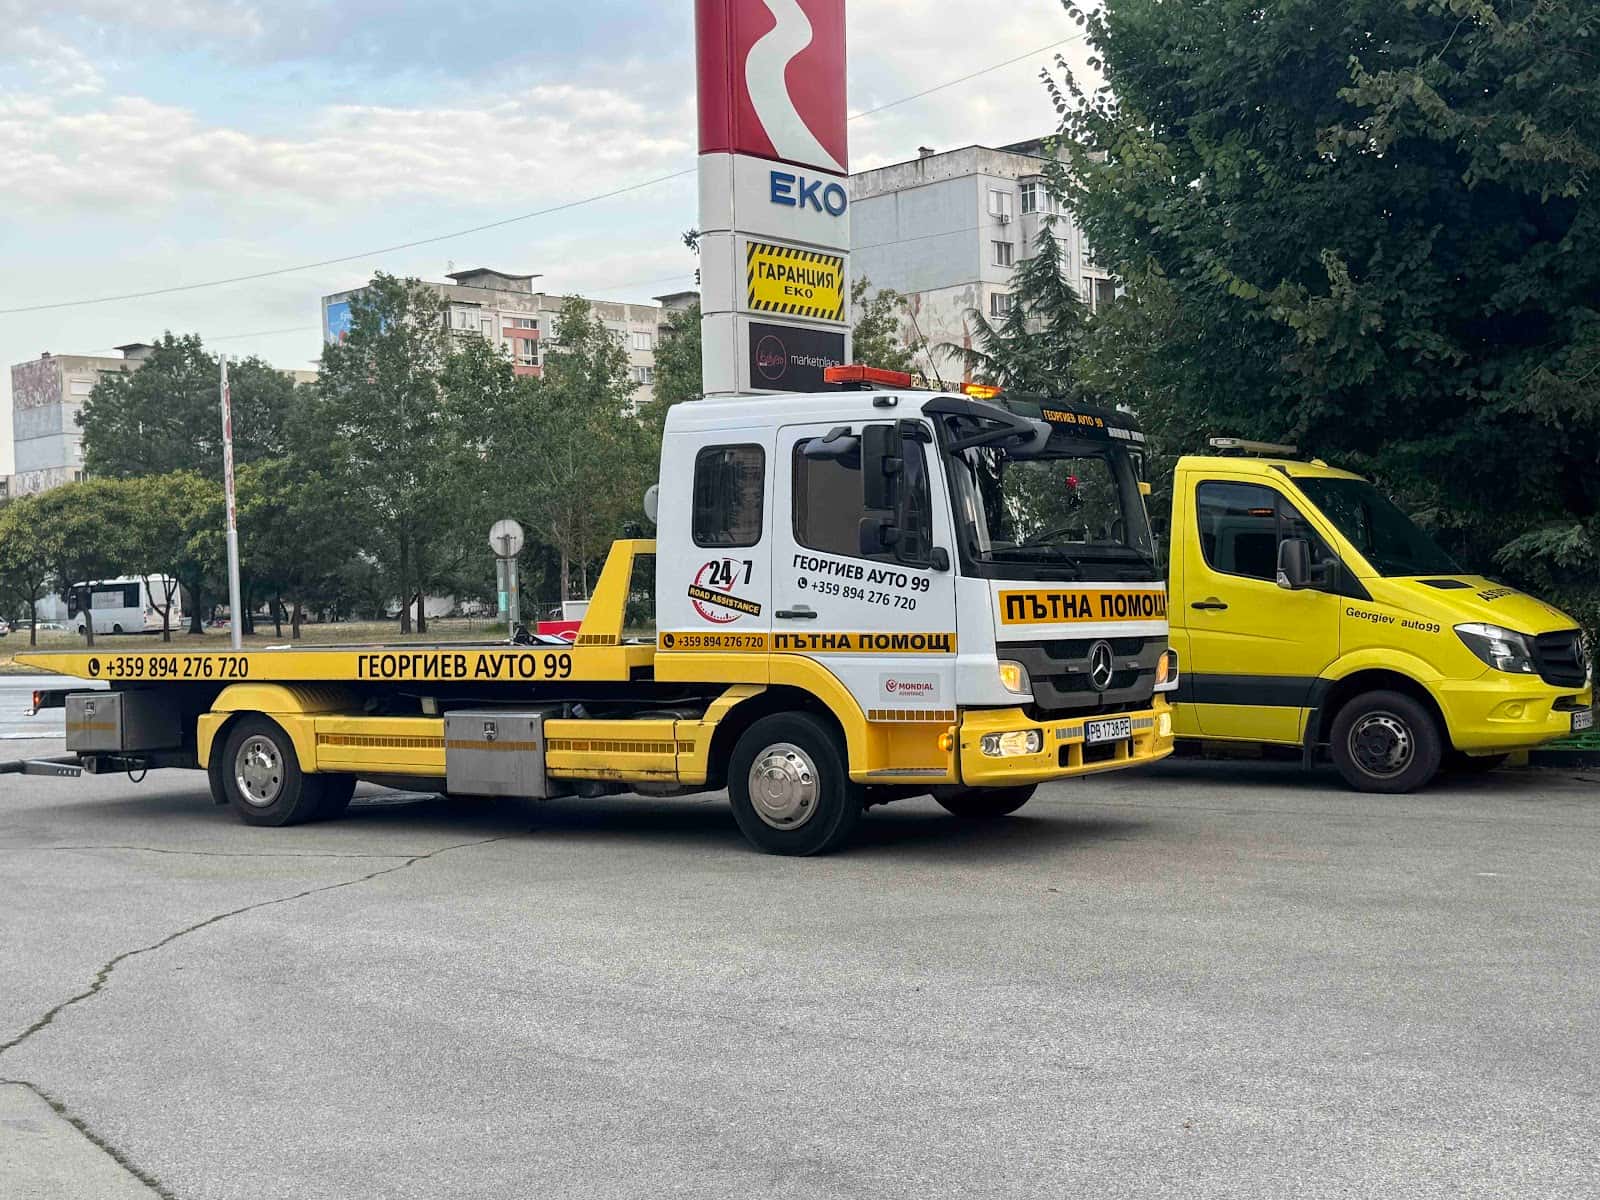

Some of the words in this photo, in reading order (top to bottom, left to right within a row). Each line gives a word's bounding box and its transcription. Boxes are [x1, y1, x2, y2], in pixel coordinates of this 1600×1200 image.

[770, 171, 848, 216] EKO
[758, 261, 834, 289] ГАРАНЦИЯ
[784, 285, 813, 299] EKO
[790, 354, 840, 368] marketplace
[1043, 409, 1076, 423] ГЕОРГИЕВ
[792, 554, 864, 580] ГЕОРГИЕВ
[867, 569, 908, 588] АУТО
[911, 576, 930, 592] 99
[689, 587, 711, 600] ROAD
[712, 594, 760, 614] ASSISTANCE
[811, 581, 839, 596] +359
[842, 585, 865, 601] 894
[868, 590, 890, 606] 276
[893, 595, 916, 611] 720
[1006, 594, 1093, 619] ПЪТНА
[1346, 607, 1396, 625] Georgiev
[1401, 619, 1440, 633] auto99
[677, 637, 701, 647] +359
[703, 636, 721, 647] 894
[724, 636, 742, 647] 276
[744, 636, 763, 648] 720
[775, 634, 851, 649] ПЪТНА
[861, 634, 950, 652] ПОМОЩ
[106, 657, 144, 677] +359
[148, 657, 178, 677] 894
[183, 657, 213, 677] 276
[218, 657, 249, 677] 720
[358, 653, 467, 678] ГЕОРГИЕВ
[474, 653, 537, 678] АУТО
[543, 653, 572, 678] 99
